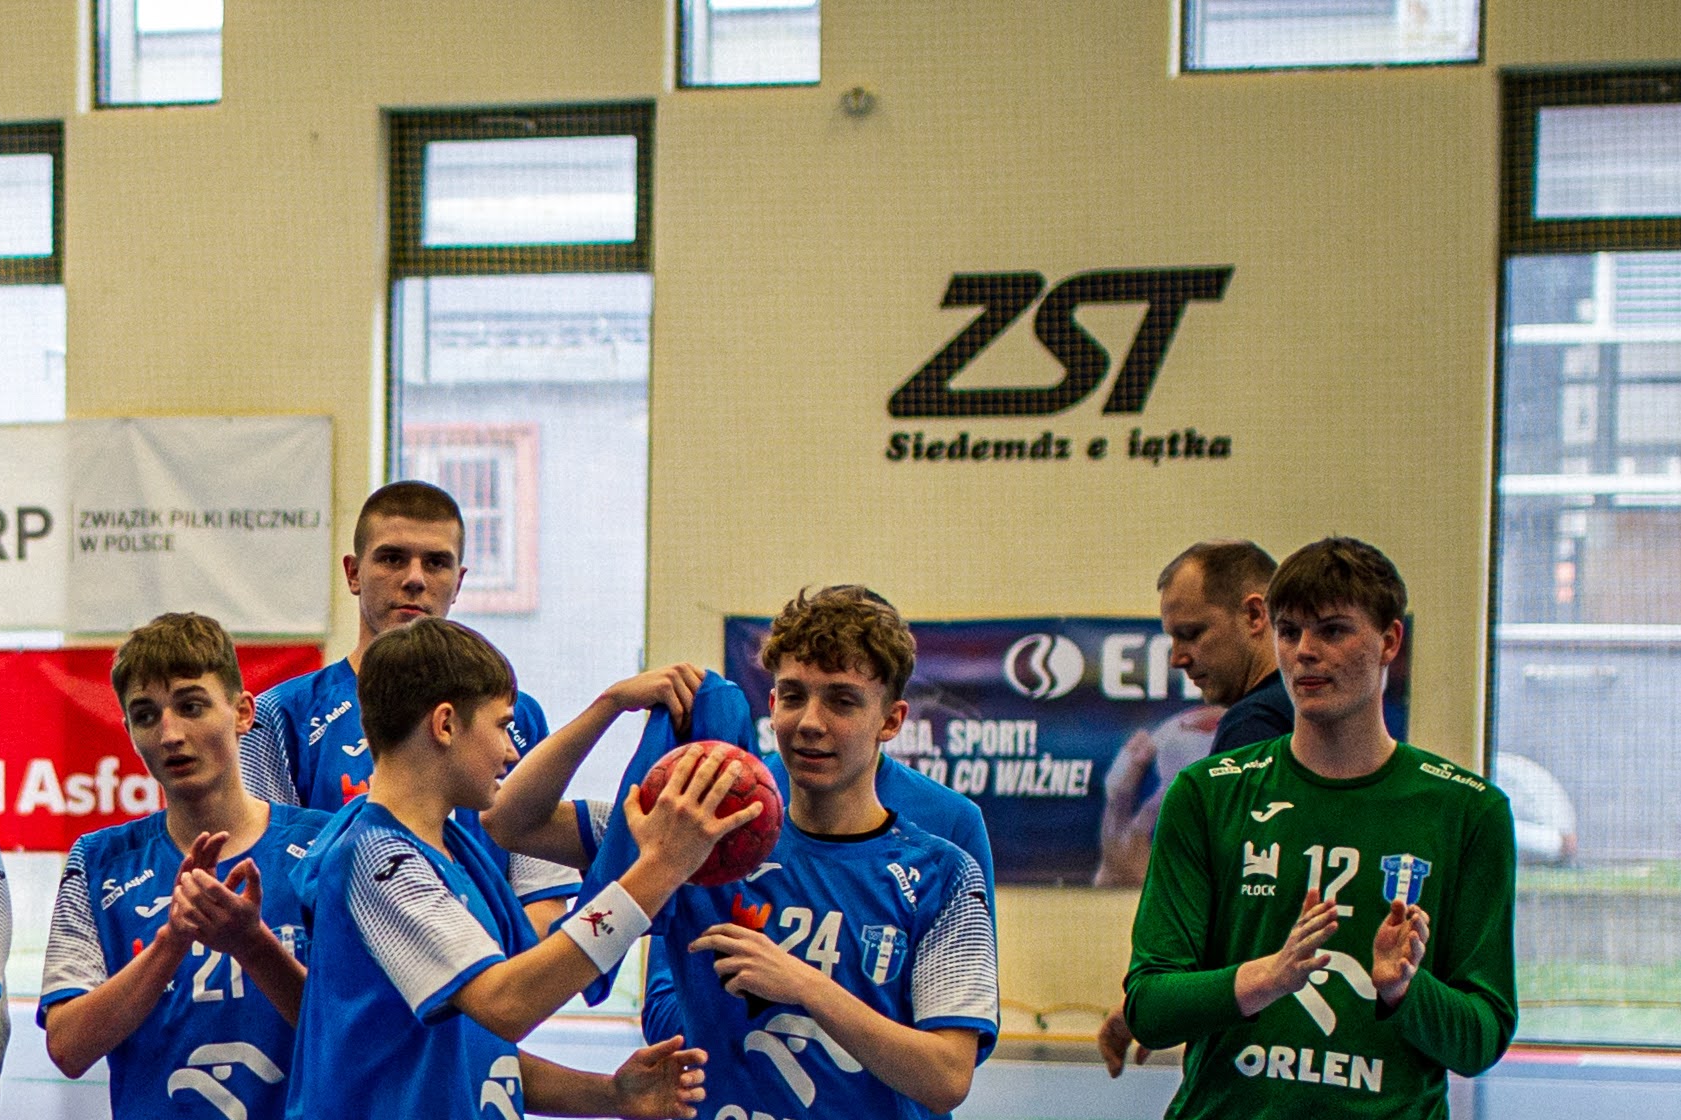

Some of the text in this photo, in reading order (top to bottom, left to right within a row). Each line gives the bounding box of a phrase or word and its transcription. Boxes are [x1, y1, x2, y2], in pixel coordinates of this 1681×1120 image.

[887, 264, 1235, 417] ZST
[79, 534, 97, 552] W
[946, 719, 1038, 758] SPORT!
[17, 755, 162, 818] Asfa
[952, 759, 989, 794] CO
[995, 752, 1093, 796] WAŻNE!
[1451, 774, 1487, 793] Asfalt
[1303, 844, 1360, 917] 12
[777, 906, 843, 978] 24
[1235, 1043, 1383, 1093] ORLEN
